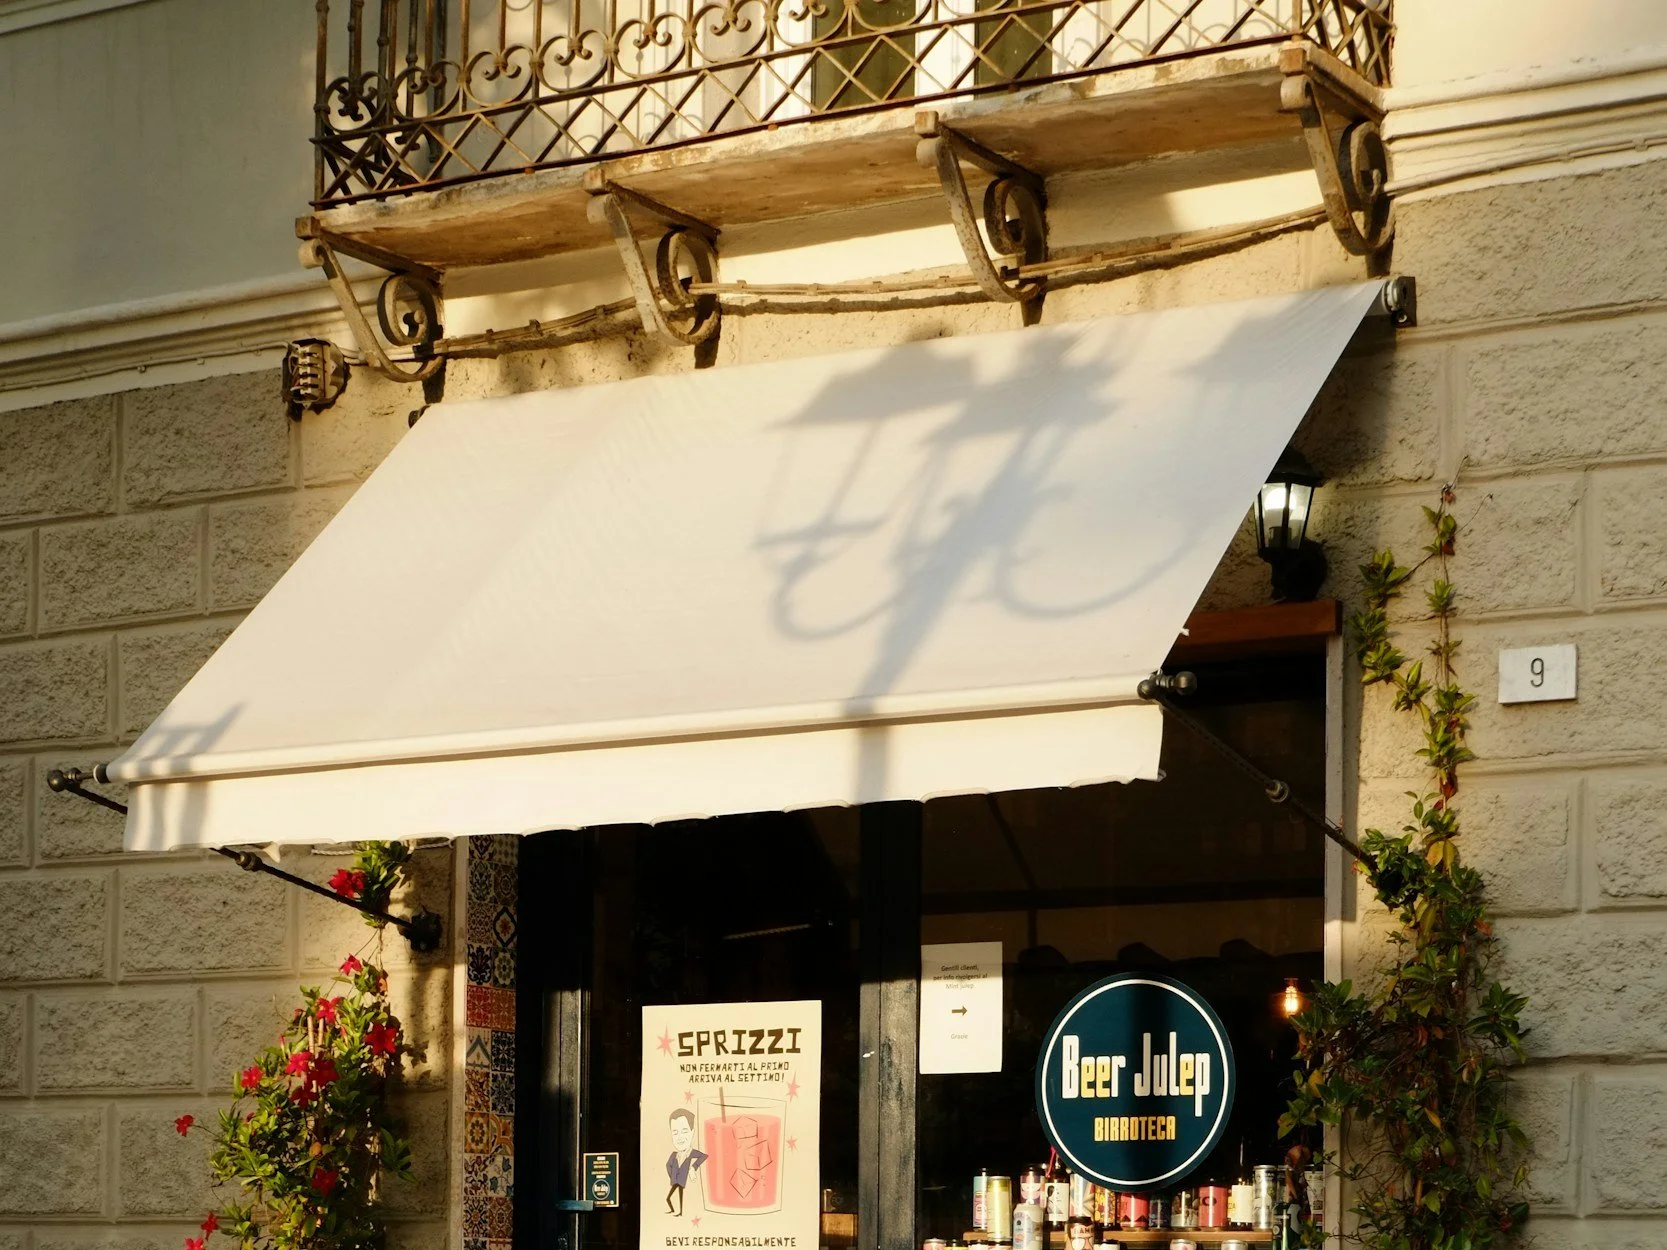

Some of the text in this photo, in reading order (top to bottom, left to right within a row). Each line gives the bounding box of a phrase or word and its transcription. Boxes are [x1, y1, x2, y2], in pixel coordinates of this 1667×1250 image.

[1530, 657, 1545, 688] 9
[677, 1028, 802, 1057] SPRIZZI
[679, 1061, 790, 1072] NON FERMARTI AL PRIMO
[688, 1072, 785, 1083] ARRIVA AL SETTIMO!
[1061, 1031, 1211, 1118] Beer Julep
[1093, 1115, 1176, 1142] BIRROTECA
[665, 1236, 797, 1247] BEVI RESPONSABILMENTE
